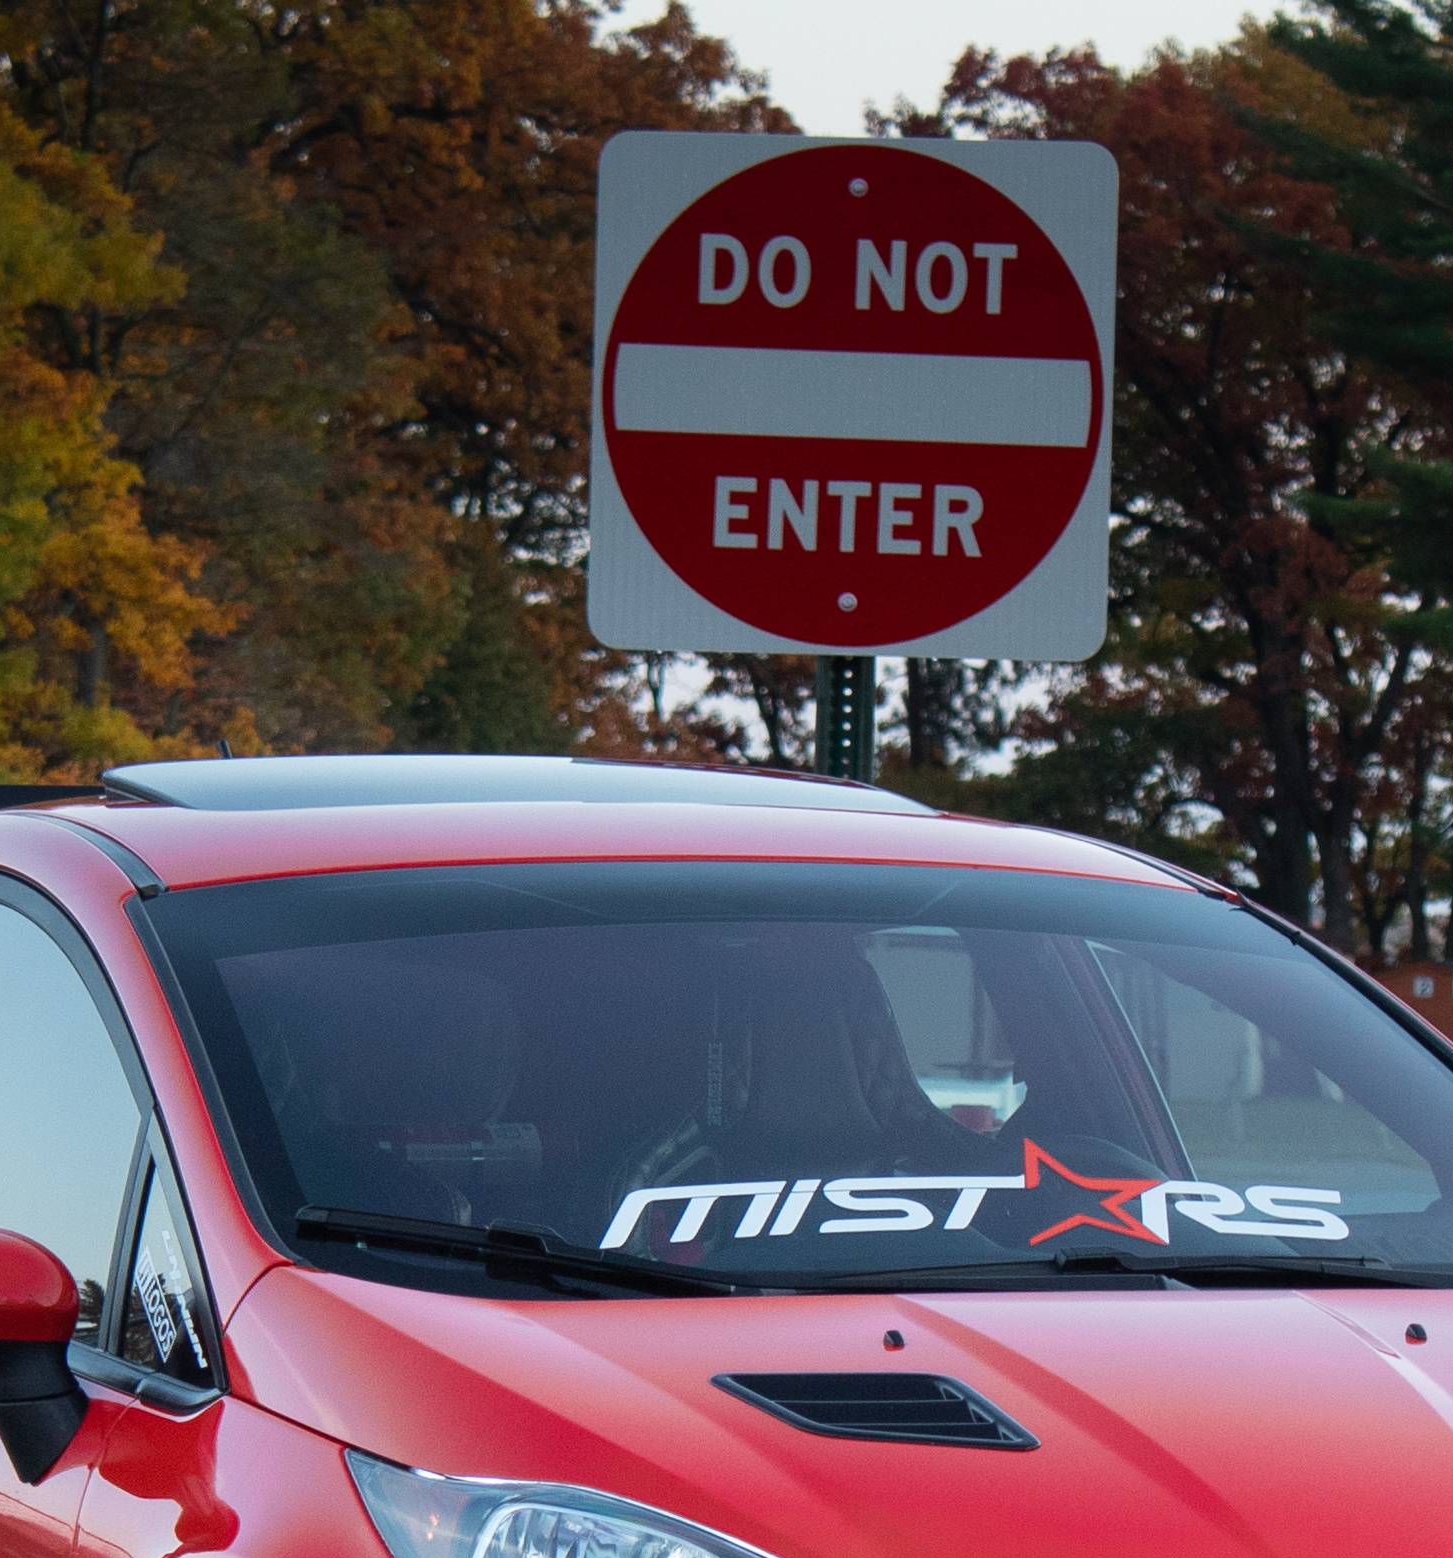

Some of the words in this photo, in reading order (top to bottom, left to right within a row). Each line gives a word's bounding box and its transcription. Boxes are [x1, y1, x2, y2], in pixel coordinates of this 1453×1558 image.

[697, 232, 812, 309] DO
[854, 238, 1018, 315] NOT
[712, 475, 984, 558] ENTER
